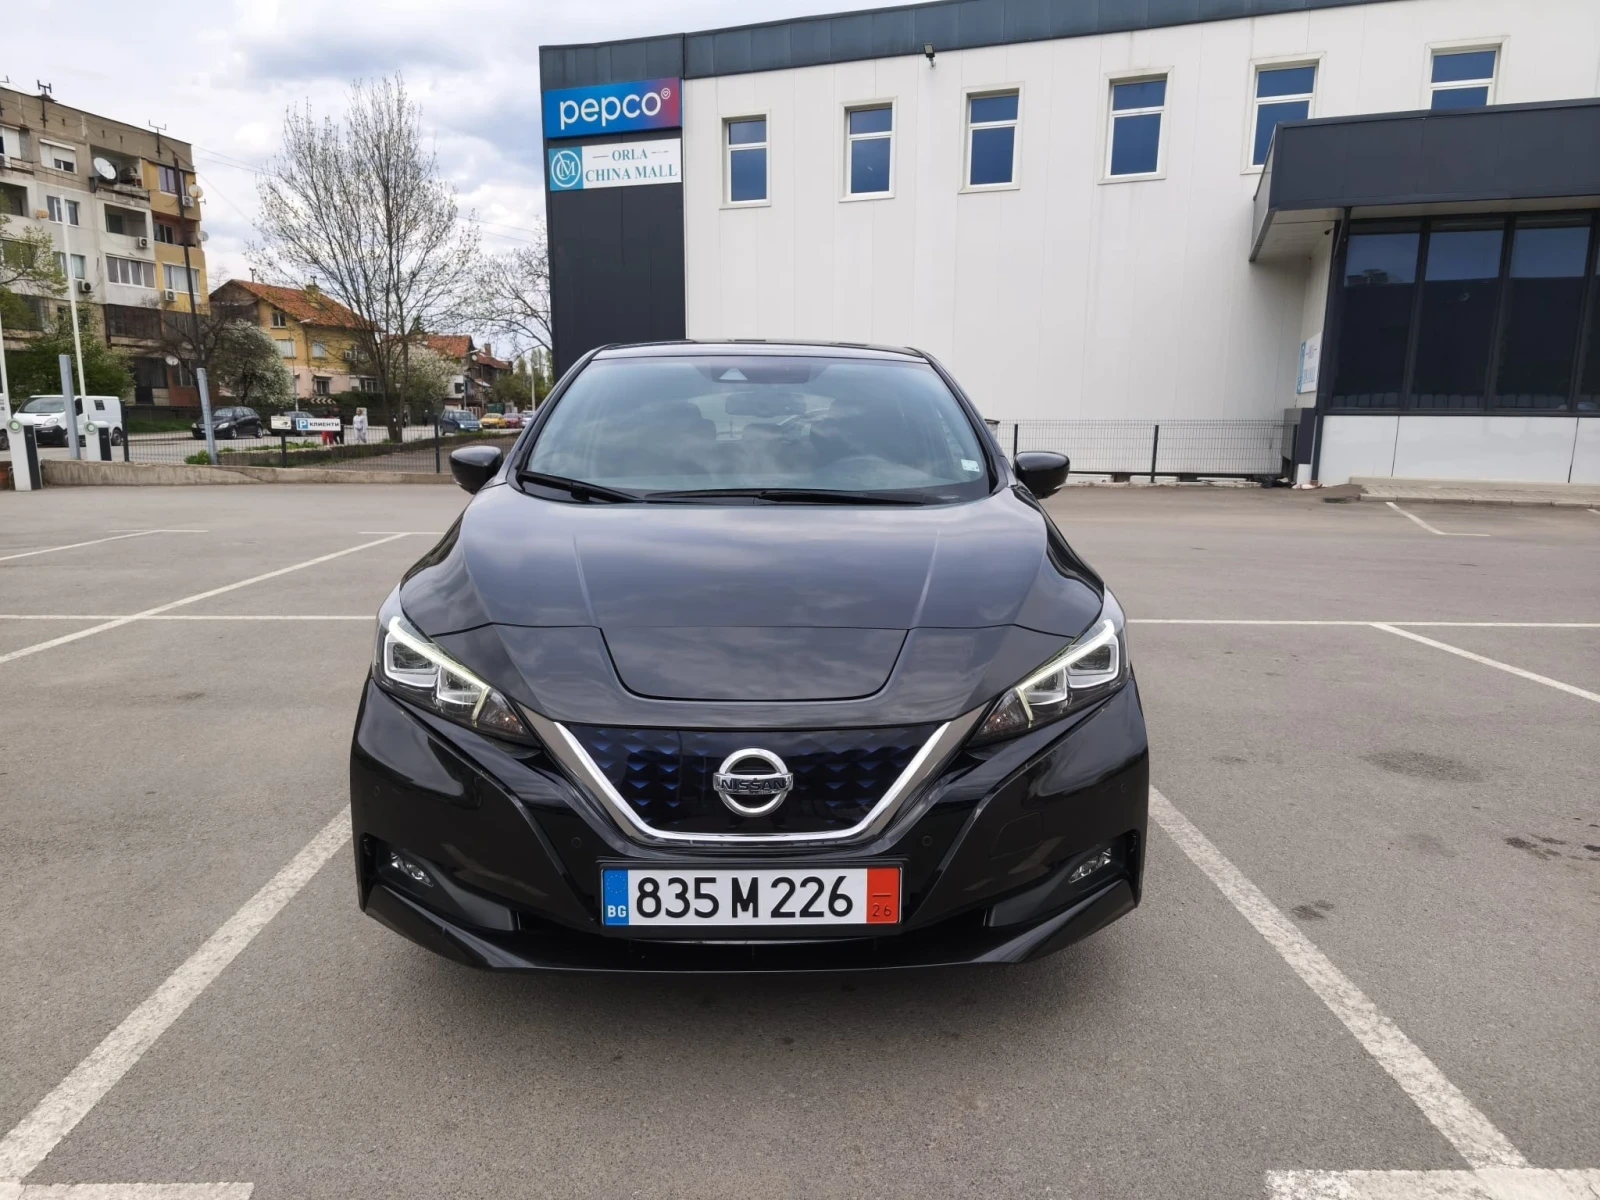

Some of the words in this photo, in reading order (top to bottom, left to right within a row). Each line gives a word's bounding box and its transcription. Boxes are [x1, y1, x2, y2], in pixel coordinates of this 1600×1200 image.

[560, 92, 661, 130] pepco
[612, 148, 648, 161] ORLA
[585, 168, 631, 181] CHINA
[635, 164, 677, 178] MALL
[721, 778, 786, 791] NISSAN
[607, 905, 627, 918] BG
[636, 876, 719, 919] 835
[731, 877, 759, 918] M
[770, 875, 853, 918] 226
[872, 903, 892, 917] 26
